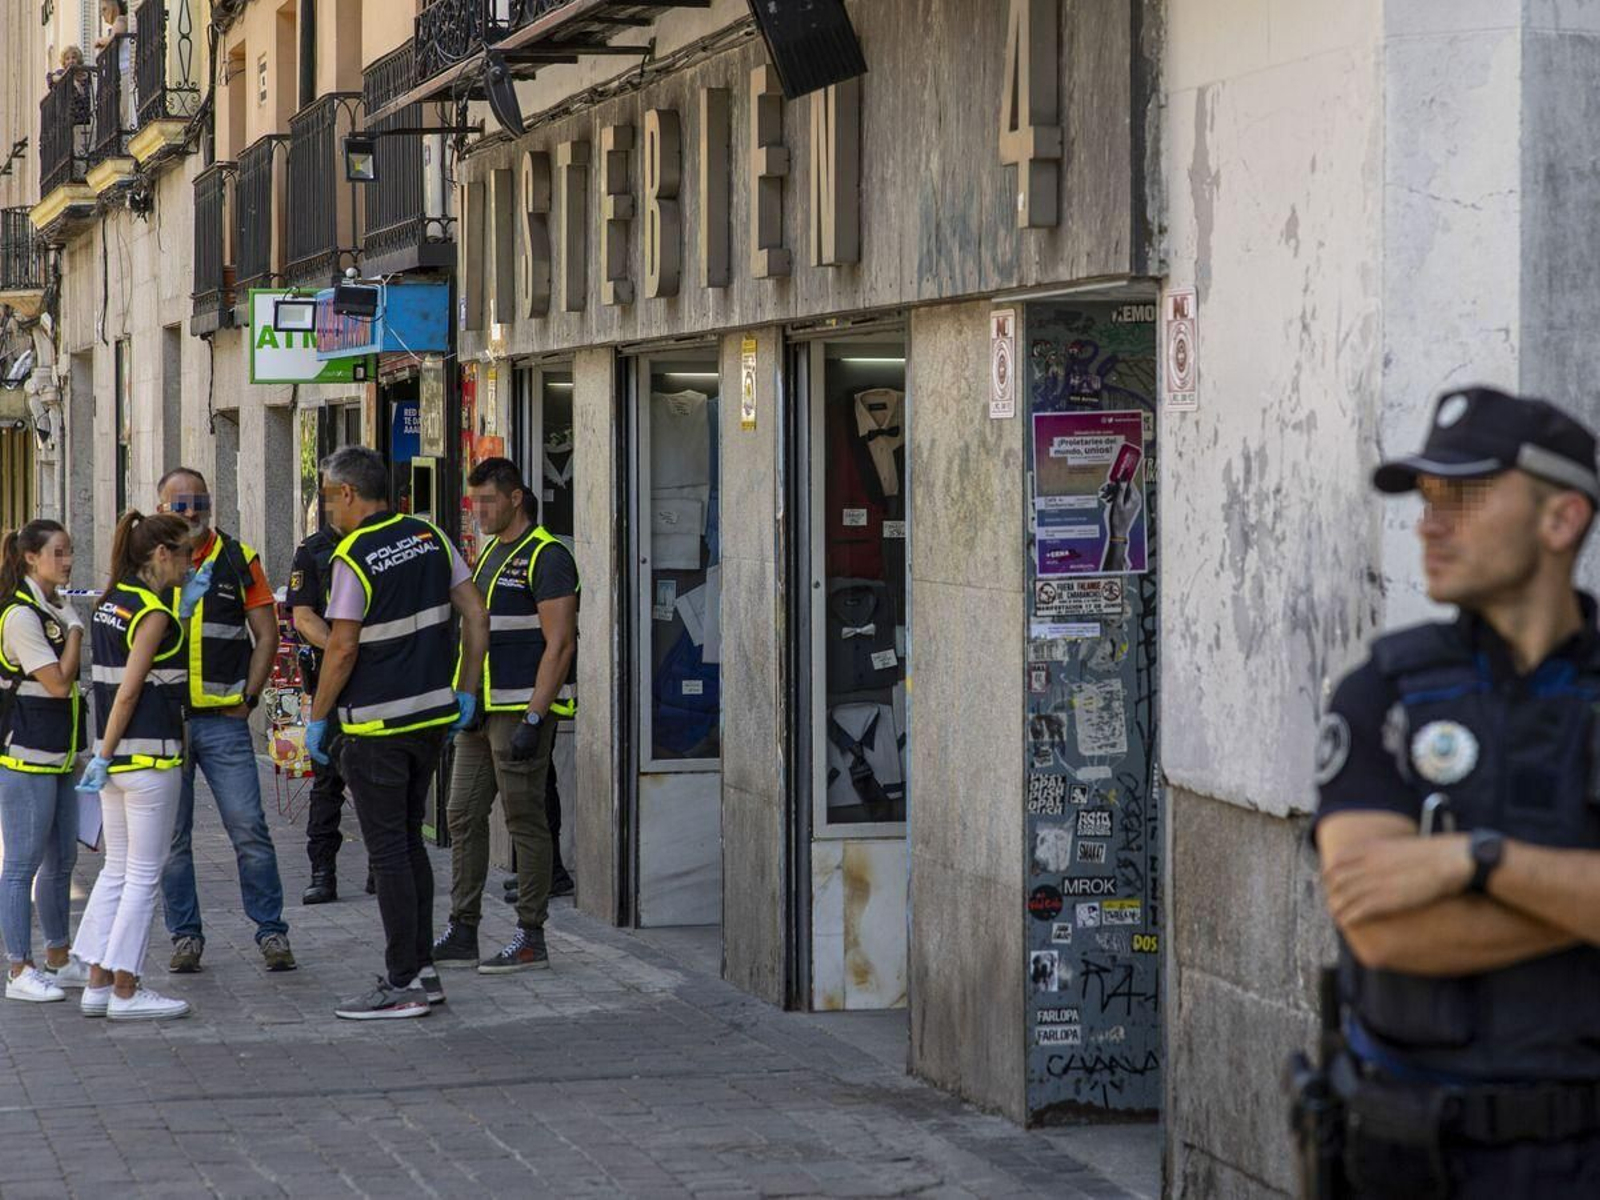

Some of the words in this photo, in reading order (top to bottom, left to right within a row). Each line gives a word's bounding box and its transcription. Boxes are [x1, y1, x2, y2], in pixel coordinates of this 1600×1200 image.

[999, 0, 1062, 228] 4
[365, 535, 422, 565] POLICIA
[371, 541, 440, 575] NACIONAL
[1064, 879, 1116, 894] MROK
[1132, 934, 1158, 951] DOS
[1036, 1009, 1079, 1023] FARLOPA
[1037, 1027, 1079, 1041] FARLOPA
